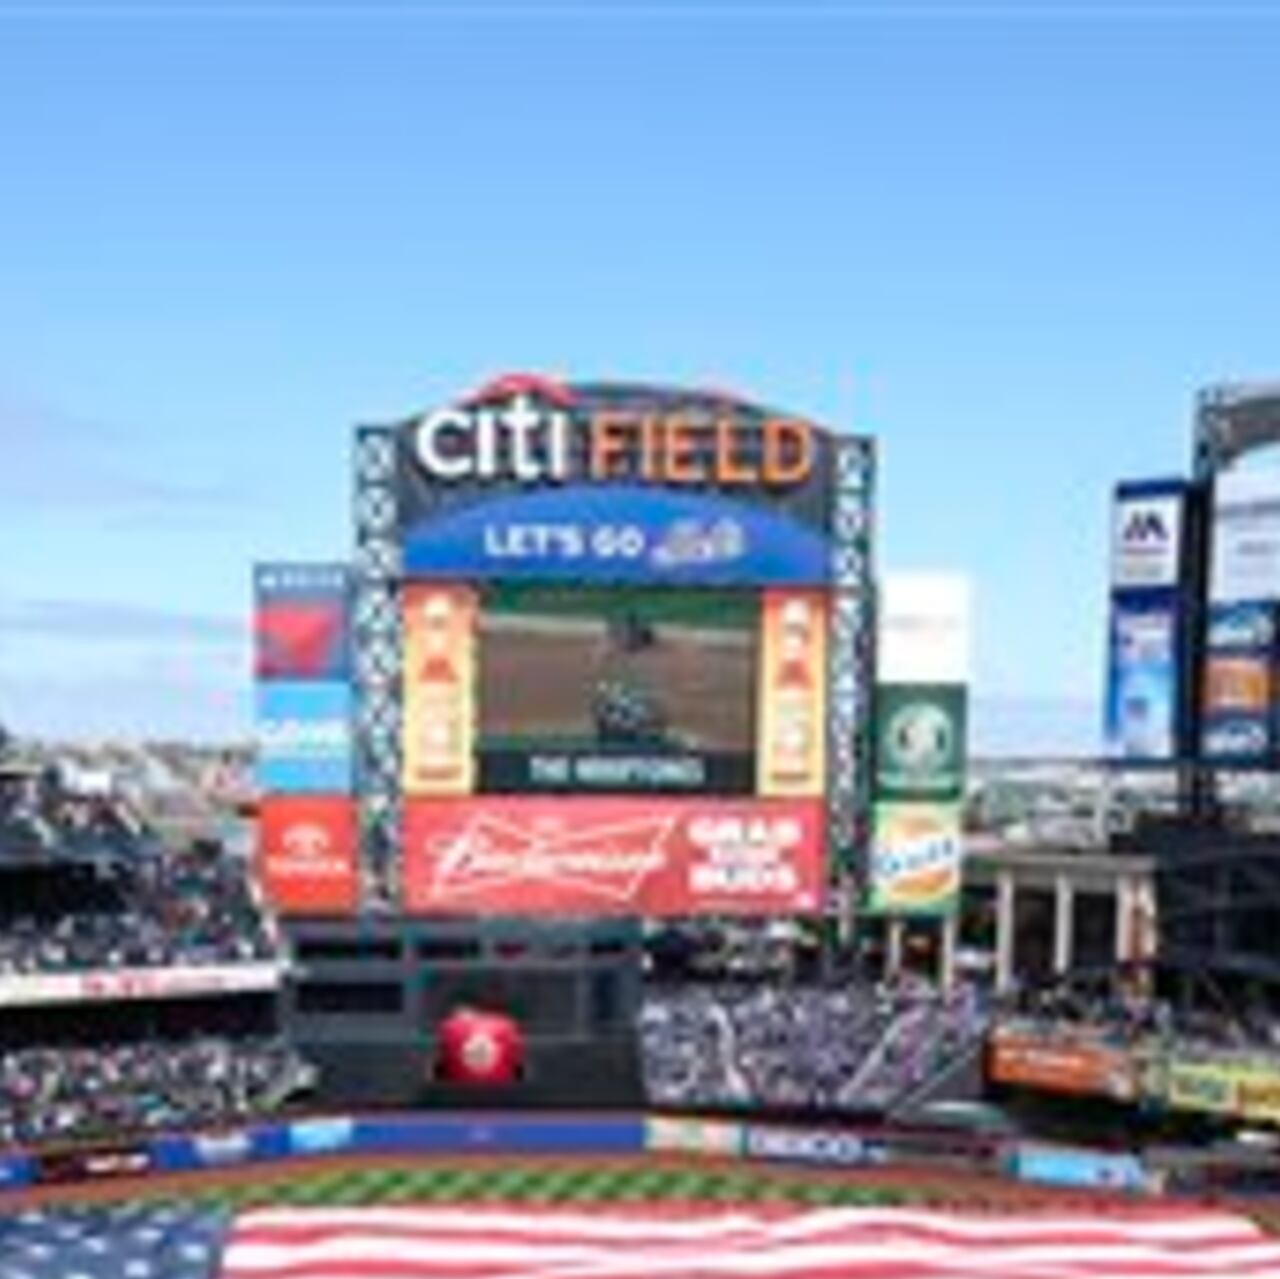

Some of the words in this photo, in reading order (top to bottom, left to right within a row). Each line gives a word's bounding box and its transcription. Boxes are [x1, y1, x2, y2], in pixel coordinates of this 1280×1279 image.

[590, 411, 813, 484] FIELD
[484, 524, 583, 558] LET'S
[592, 526, 644, 558] GO
